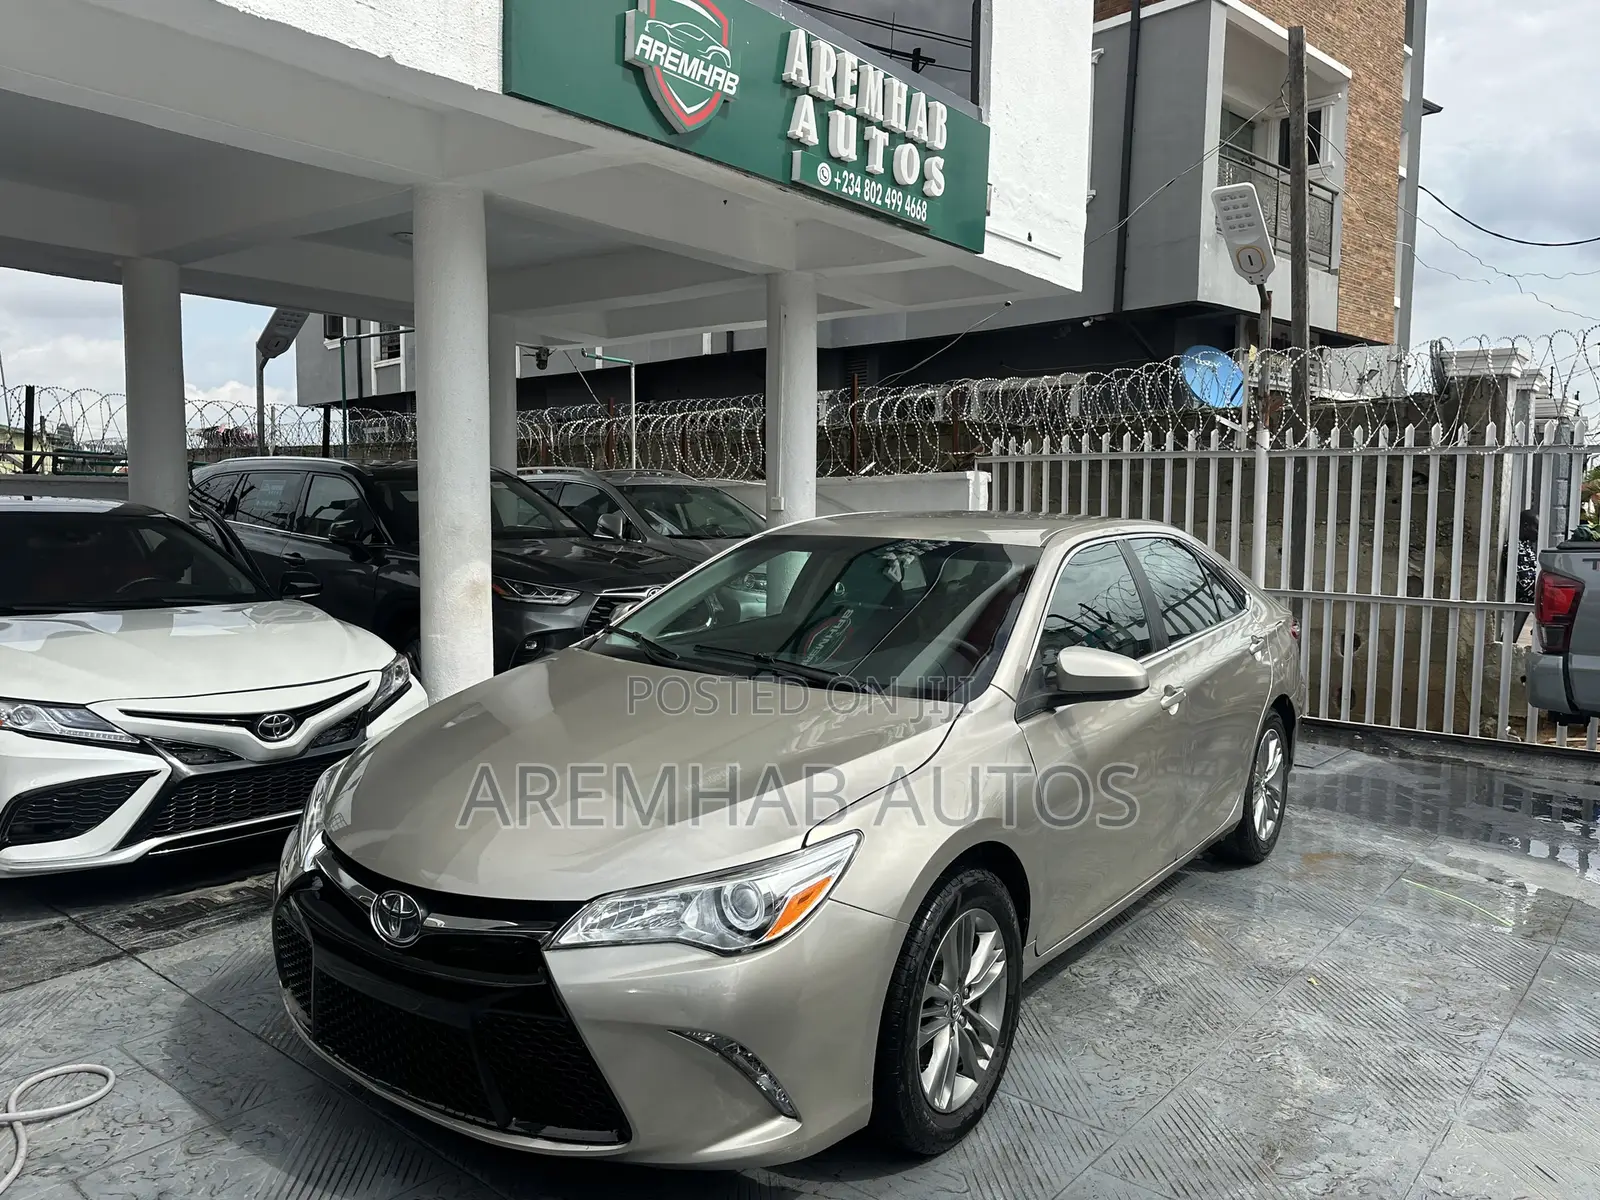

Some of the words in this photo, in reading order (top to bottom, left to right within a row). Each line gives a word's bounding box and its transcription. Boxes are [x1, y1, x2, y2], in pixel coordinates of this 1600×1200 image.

[635, 33, 740, 96] AREMHAB
[782, 28, 948, 151] AREMHAB
[787, 94, 945, 197] AUTOS
[834, 170, 861, 198] +234
[863, 179, 882, 206] 802
[884, 187, 903, 213] 499
[904, 195, 928, 222] 4668
